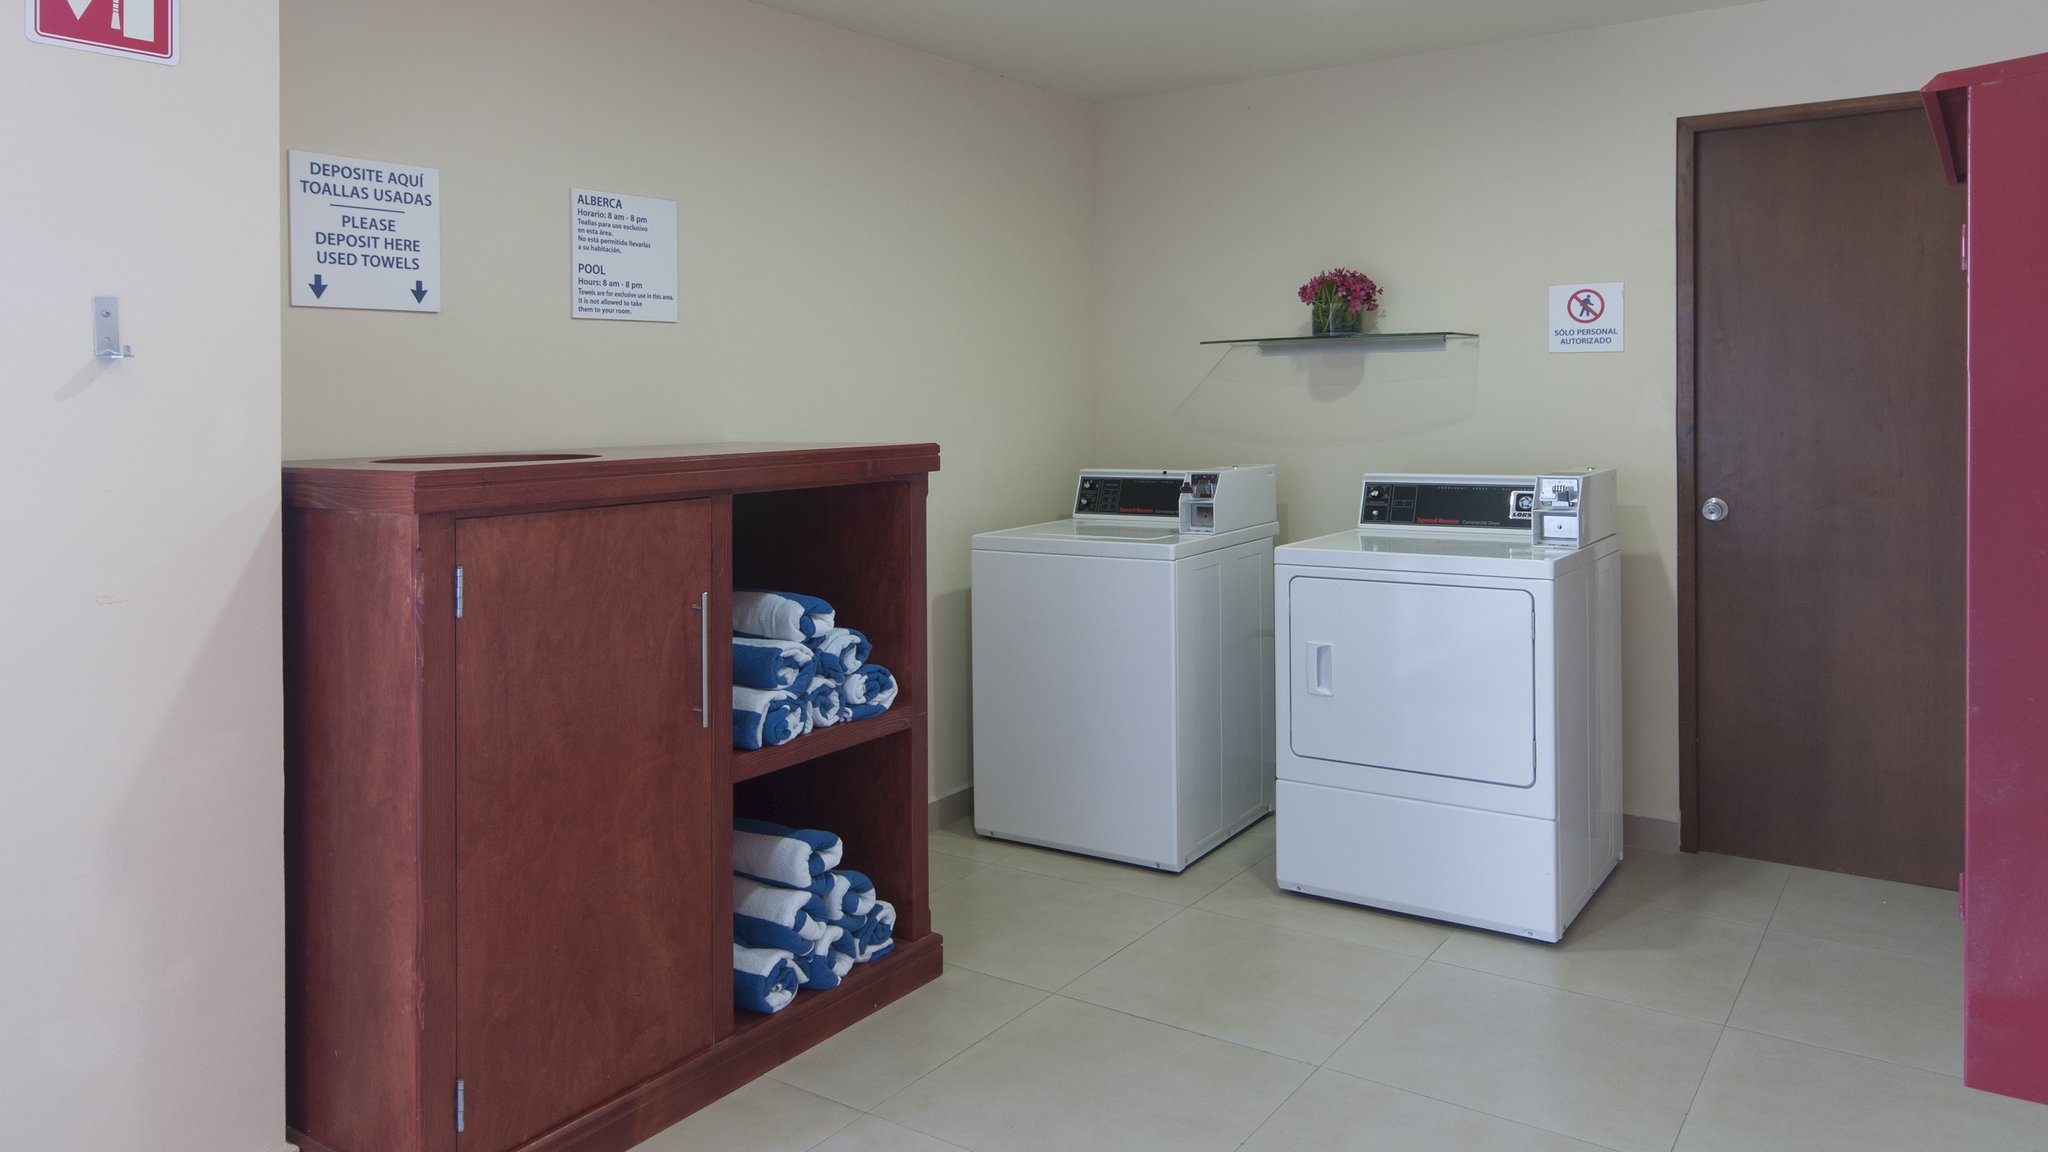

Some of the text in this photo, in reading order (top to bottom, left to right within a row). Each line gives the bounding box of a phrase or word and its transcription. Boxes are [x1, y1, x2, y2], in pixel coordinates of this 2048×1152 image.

[310, 162, 424, 188] DEPOSITE AQUÍ
[300, 180, 432, 206] TOALLAS USADAS
[578, 194, 622, 209] ALBERCA
[578, 208, 606, 218] Horario:
[342, 216, 396, 232] PLEASE
[578, 218, 597, 226] Toallas
[316, 232, 420, 252] DEPOSIT HERE
[591, 245, 622, 254] habitación.
[316, 251, 419, 270] USED TOWELS
[578, 263, 606, 275] POOL
[578, 278, 601, 286] Hours:
[1554, 328, 1575, 336] SÓLO
